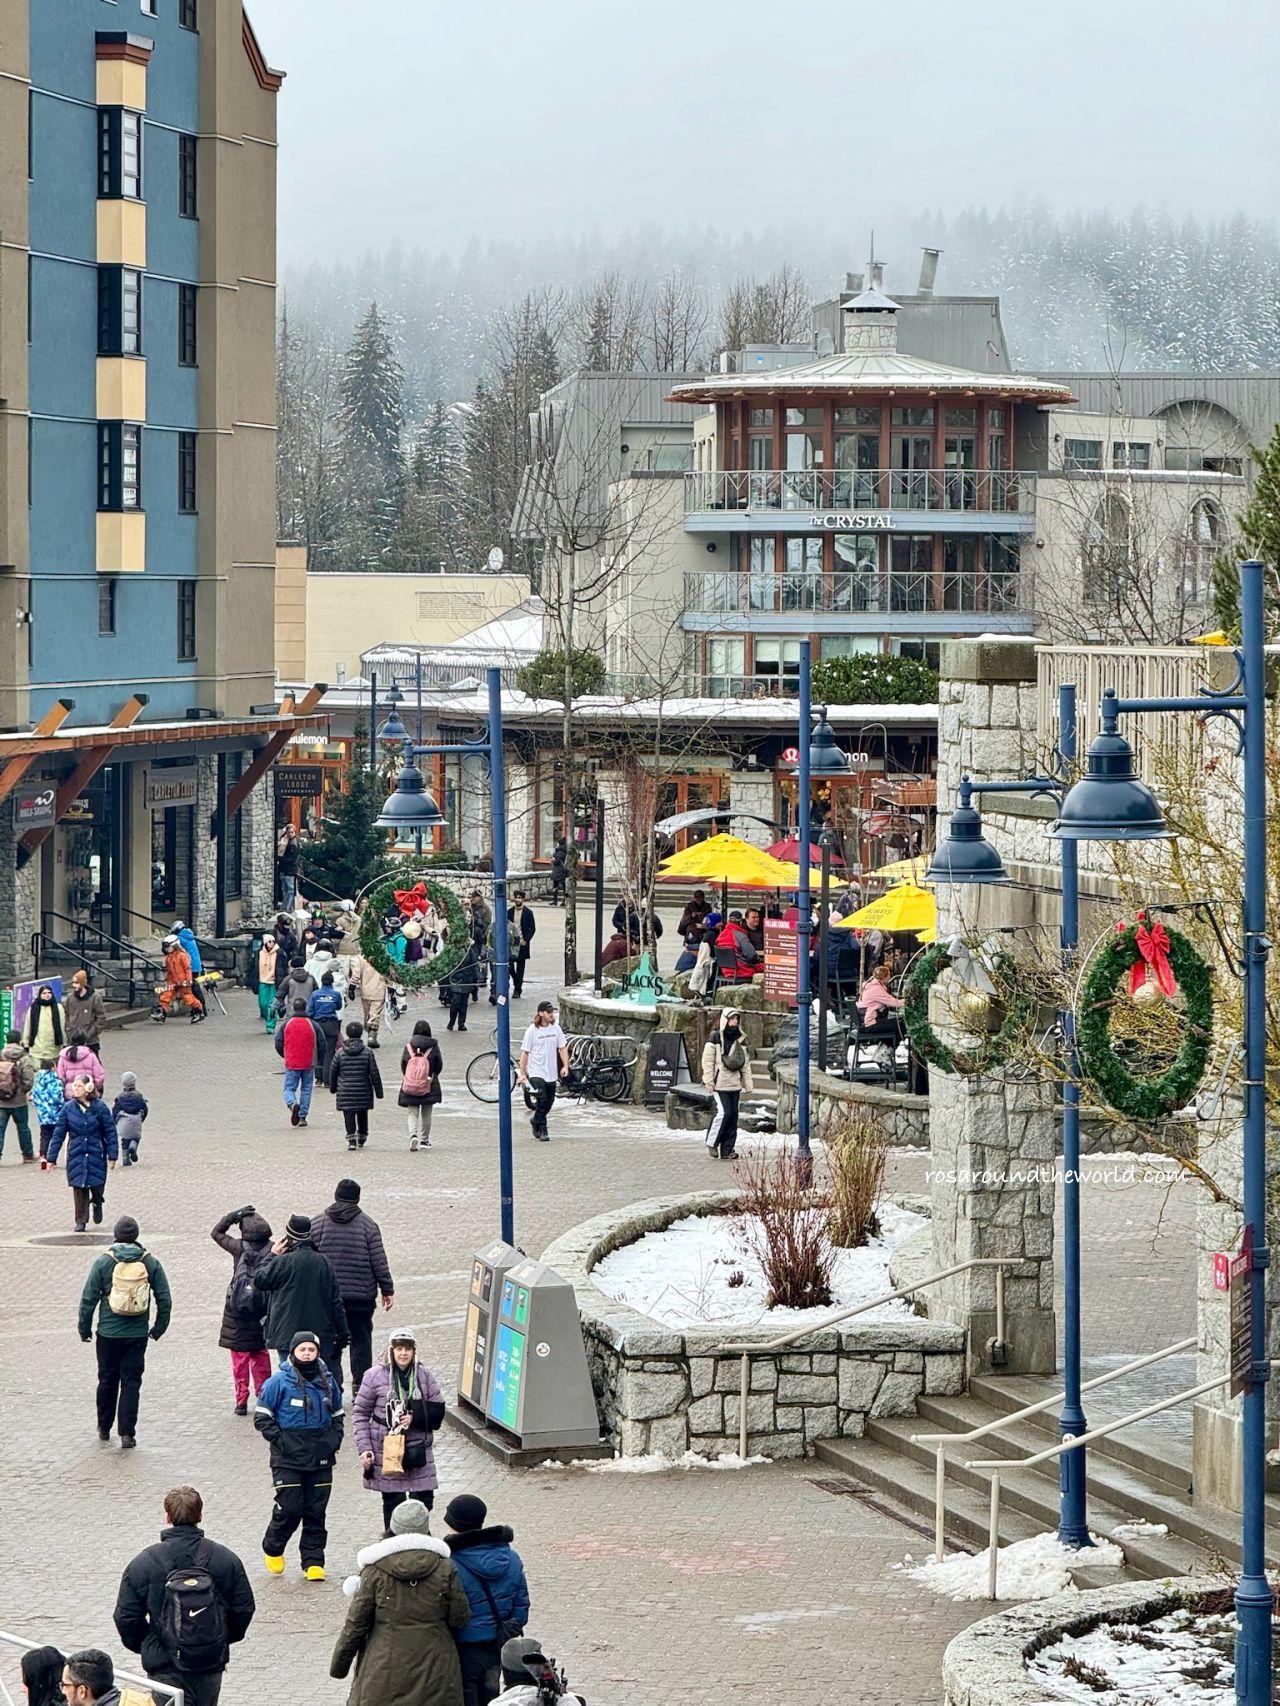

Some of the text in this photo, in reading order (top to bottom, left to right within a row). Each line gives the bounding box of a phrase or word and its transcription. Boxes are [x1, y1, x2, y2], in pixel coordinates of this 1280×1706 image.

[823, 515, 896, 528] CRYSTAL
[278, 772, 316, 780] CARLETON
[622, 974, 662, 996] BLACKS
